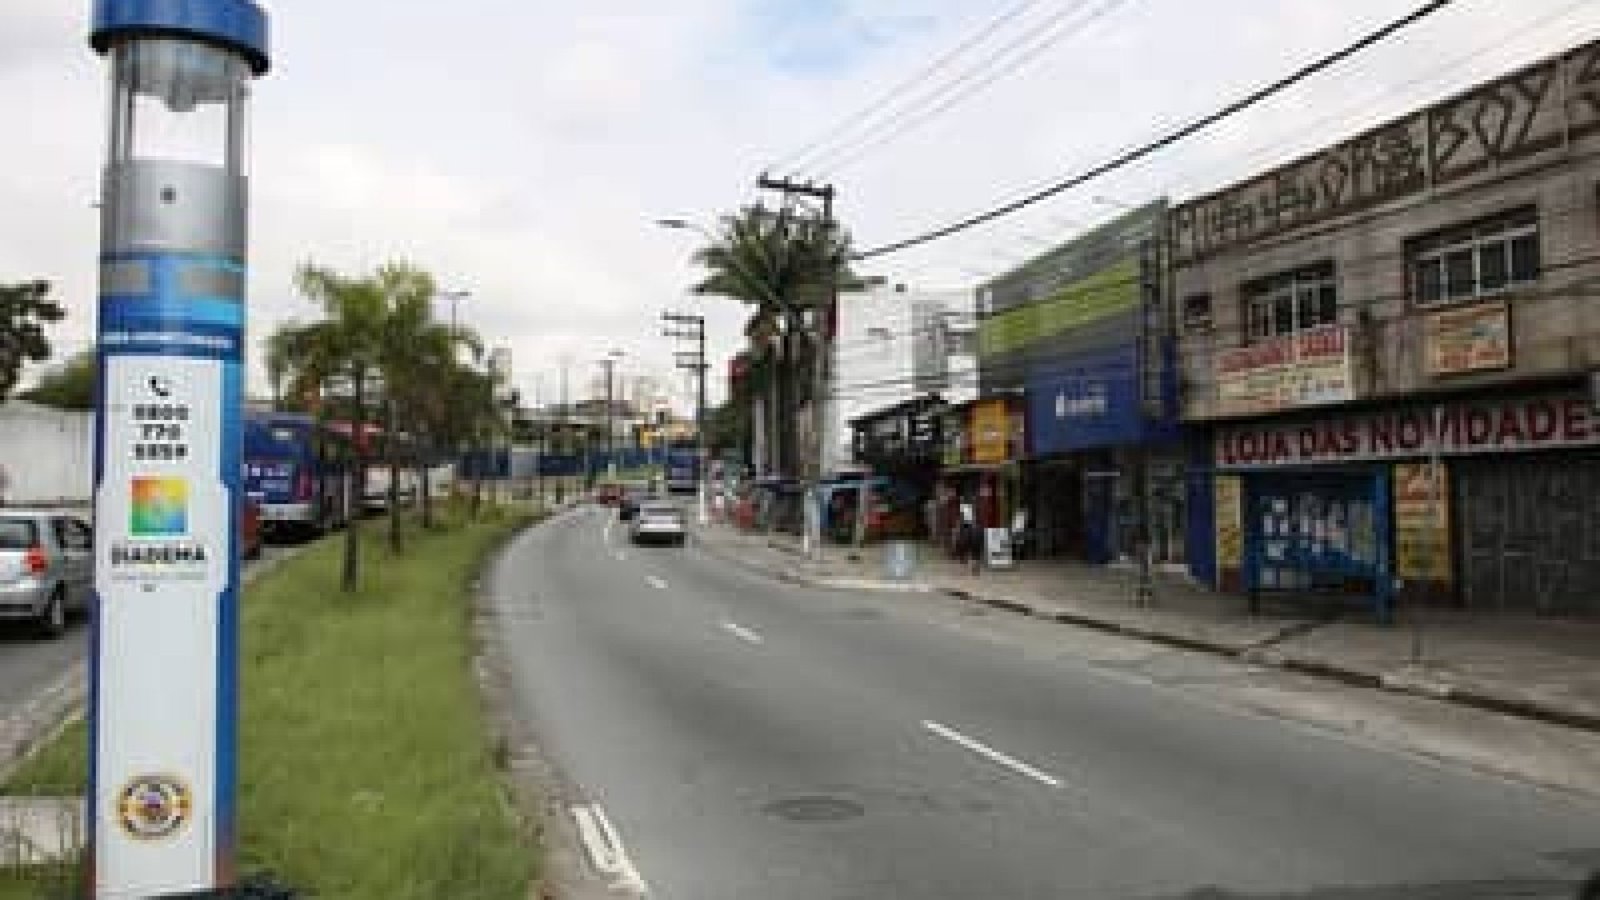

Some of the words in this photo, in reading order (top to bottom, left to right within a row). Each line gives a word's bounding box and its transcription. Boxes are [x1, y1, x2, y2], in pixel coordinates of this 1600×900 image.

[1220, 429, 1290, 464] LOJA
[1299, 420, 1360, 458] DAS
[1371, 398, 1600, 453] NOVIDADE
[110, 545, 206, 565] DIADEMA
